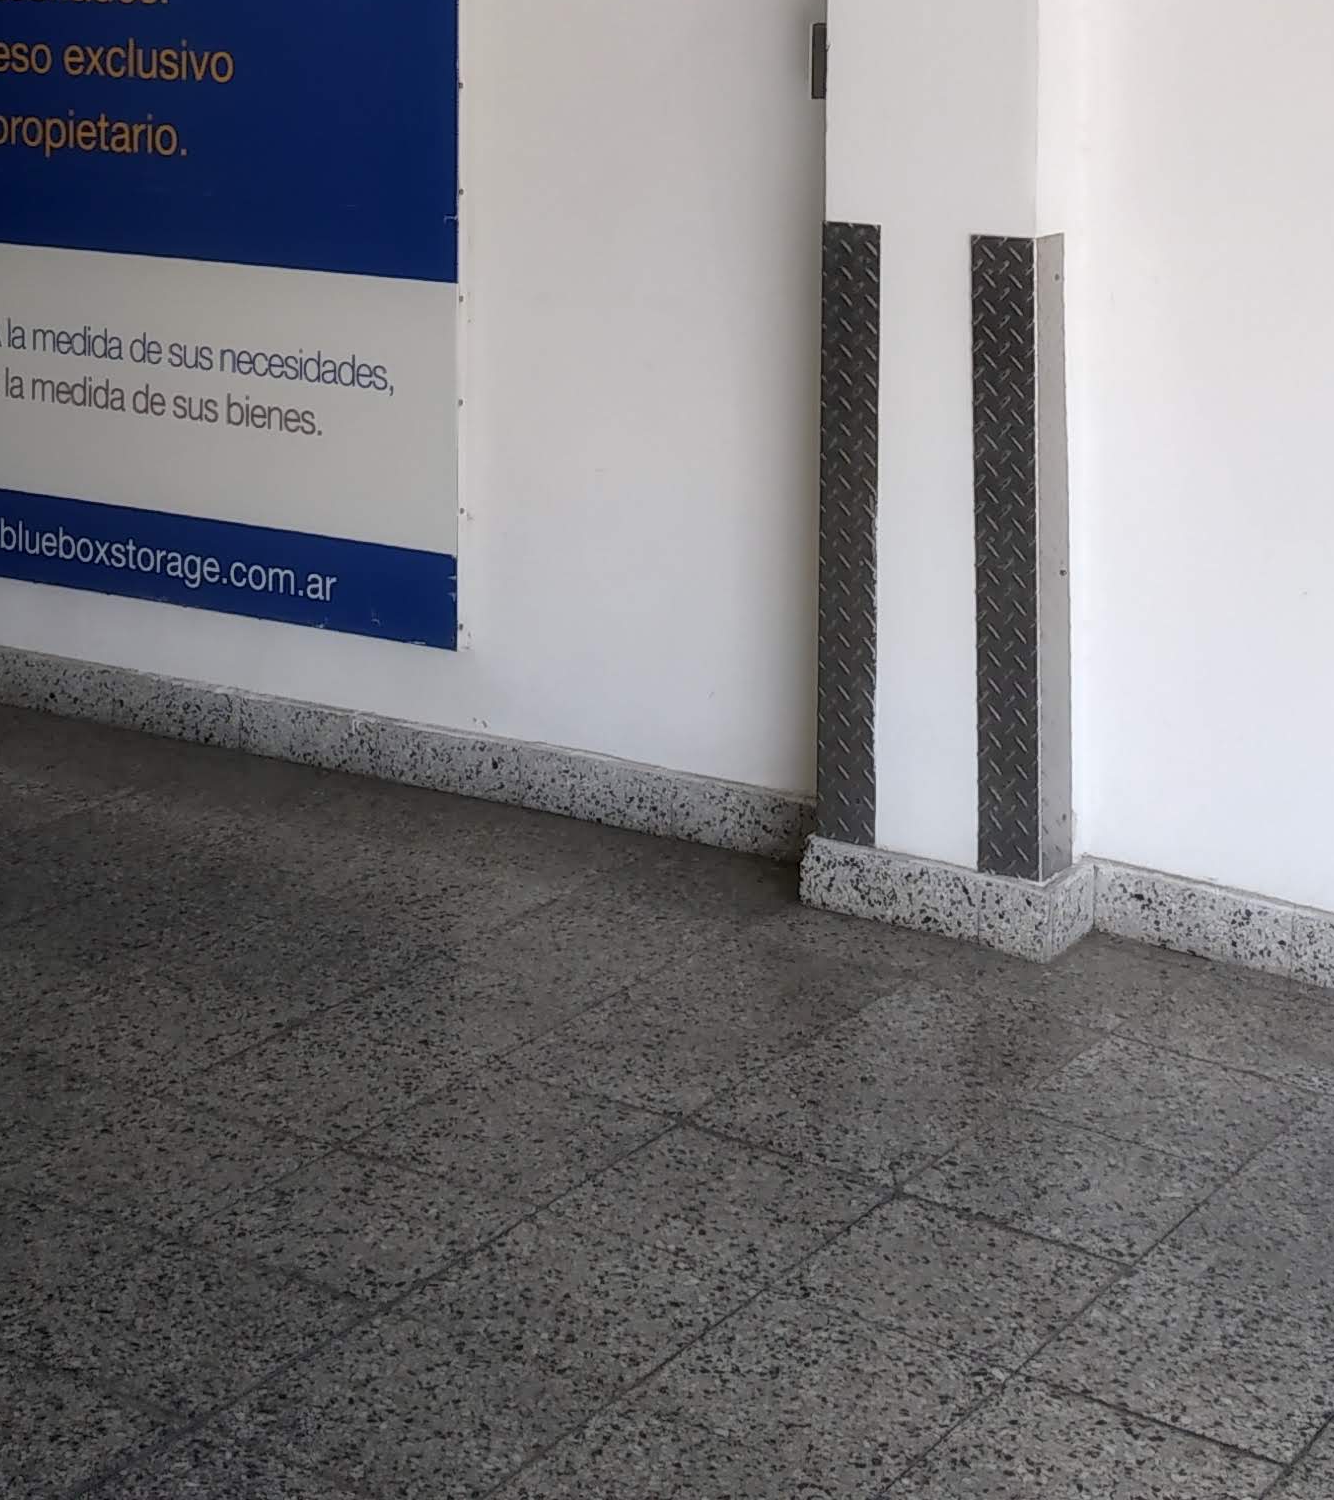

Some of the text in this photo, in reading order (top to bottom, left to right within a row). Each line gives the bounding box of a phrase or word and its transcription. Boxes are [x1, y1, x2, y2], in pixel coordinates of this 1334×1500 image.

[63, 37, 235, 83] exclusivo
[7, 319, 27, 351] la
[33, 324, 124, 362] medida
[129, 333, 162, 365] de
[168, 342, 213, 372] sus
[219, 346, 395, 396] necesidades,
[5, 370, 26, 399] la
[32, 374, 126, 412] medida
[132, 383, 166, 416] de
[173, 396, 219, 423] sus
[226, 394, 323, 437] bienes.
